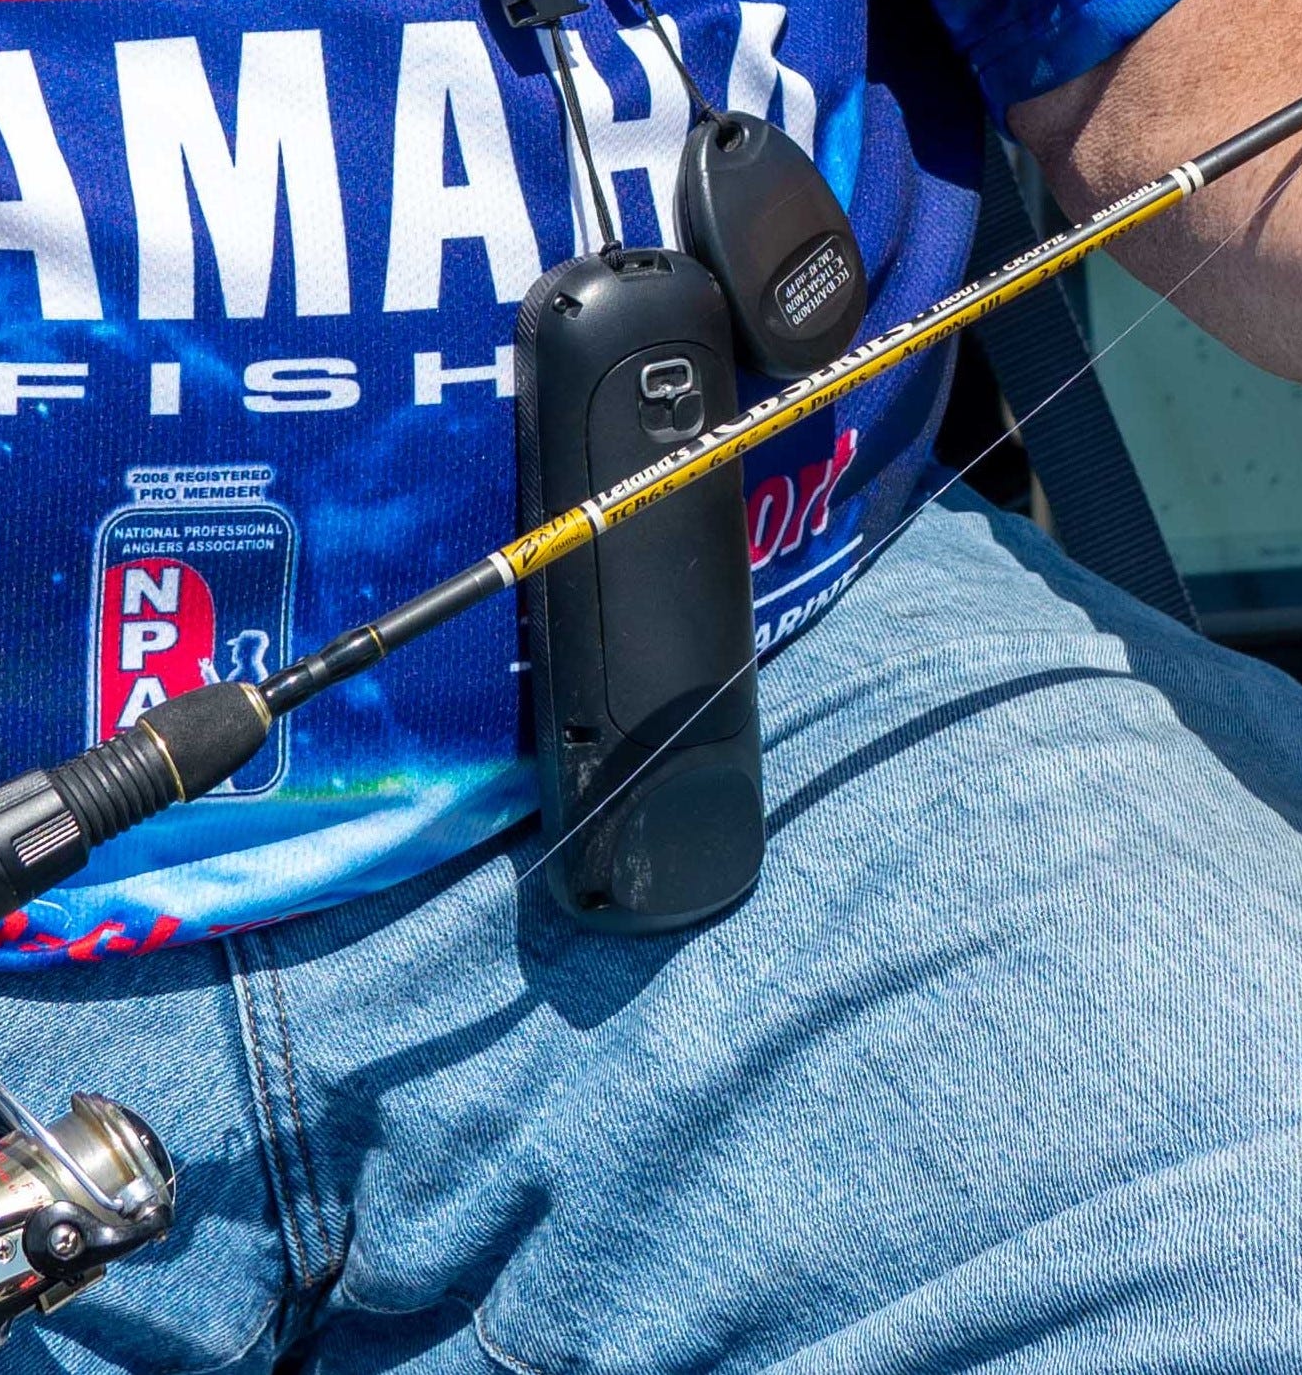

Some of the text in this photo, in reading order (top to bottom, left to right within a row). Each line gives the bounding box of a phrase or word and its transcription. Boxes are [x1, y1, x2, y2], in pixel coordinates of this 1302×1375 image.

[174, 468, 272, 483] REGISTERED
[139, 485, 261, 501] PRO MEMBER
[113, 522, 283, 541] NATIONAL PROFESSIONAL
[121, 538, 275, 555] ANGLERS ASSOCIATION
